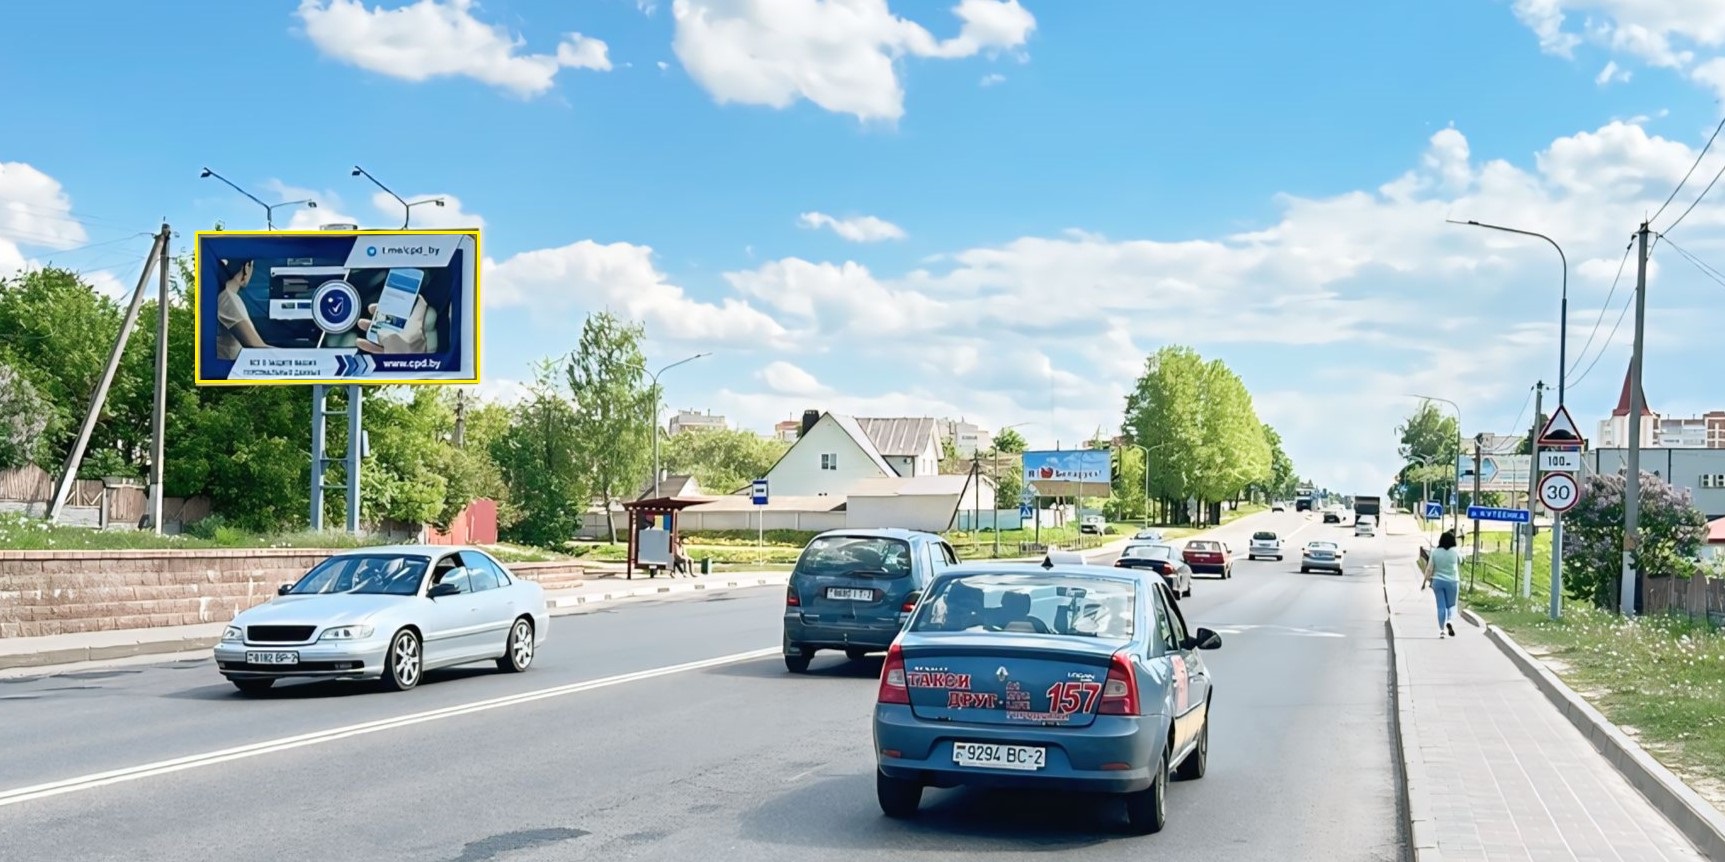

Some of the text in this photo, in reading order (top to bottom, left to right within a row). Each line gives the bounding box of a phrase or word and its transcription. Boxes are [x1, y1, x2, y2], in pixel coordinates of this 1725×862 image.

[383, 358, 441, 370] www.cpd.by
[1548, 456, 1565, 466] 100
[1547, 485, 1570, 500] 30
[907, 672, 971, 690] ТАКСИ
[947, 691, 998, 709] ДРУГ
[1046, 682, 1102, 715] 157
[967, 745, 1001, 761] 9294
[1006, 747, 1043, 765] BC-2
